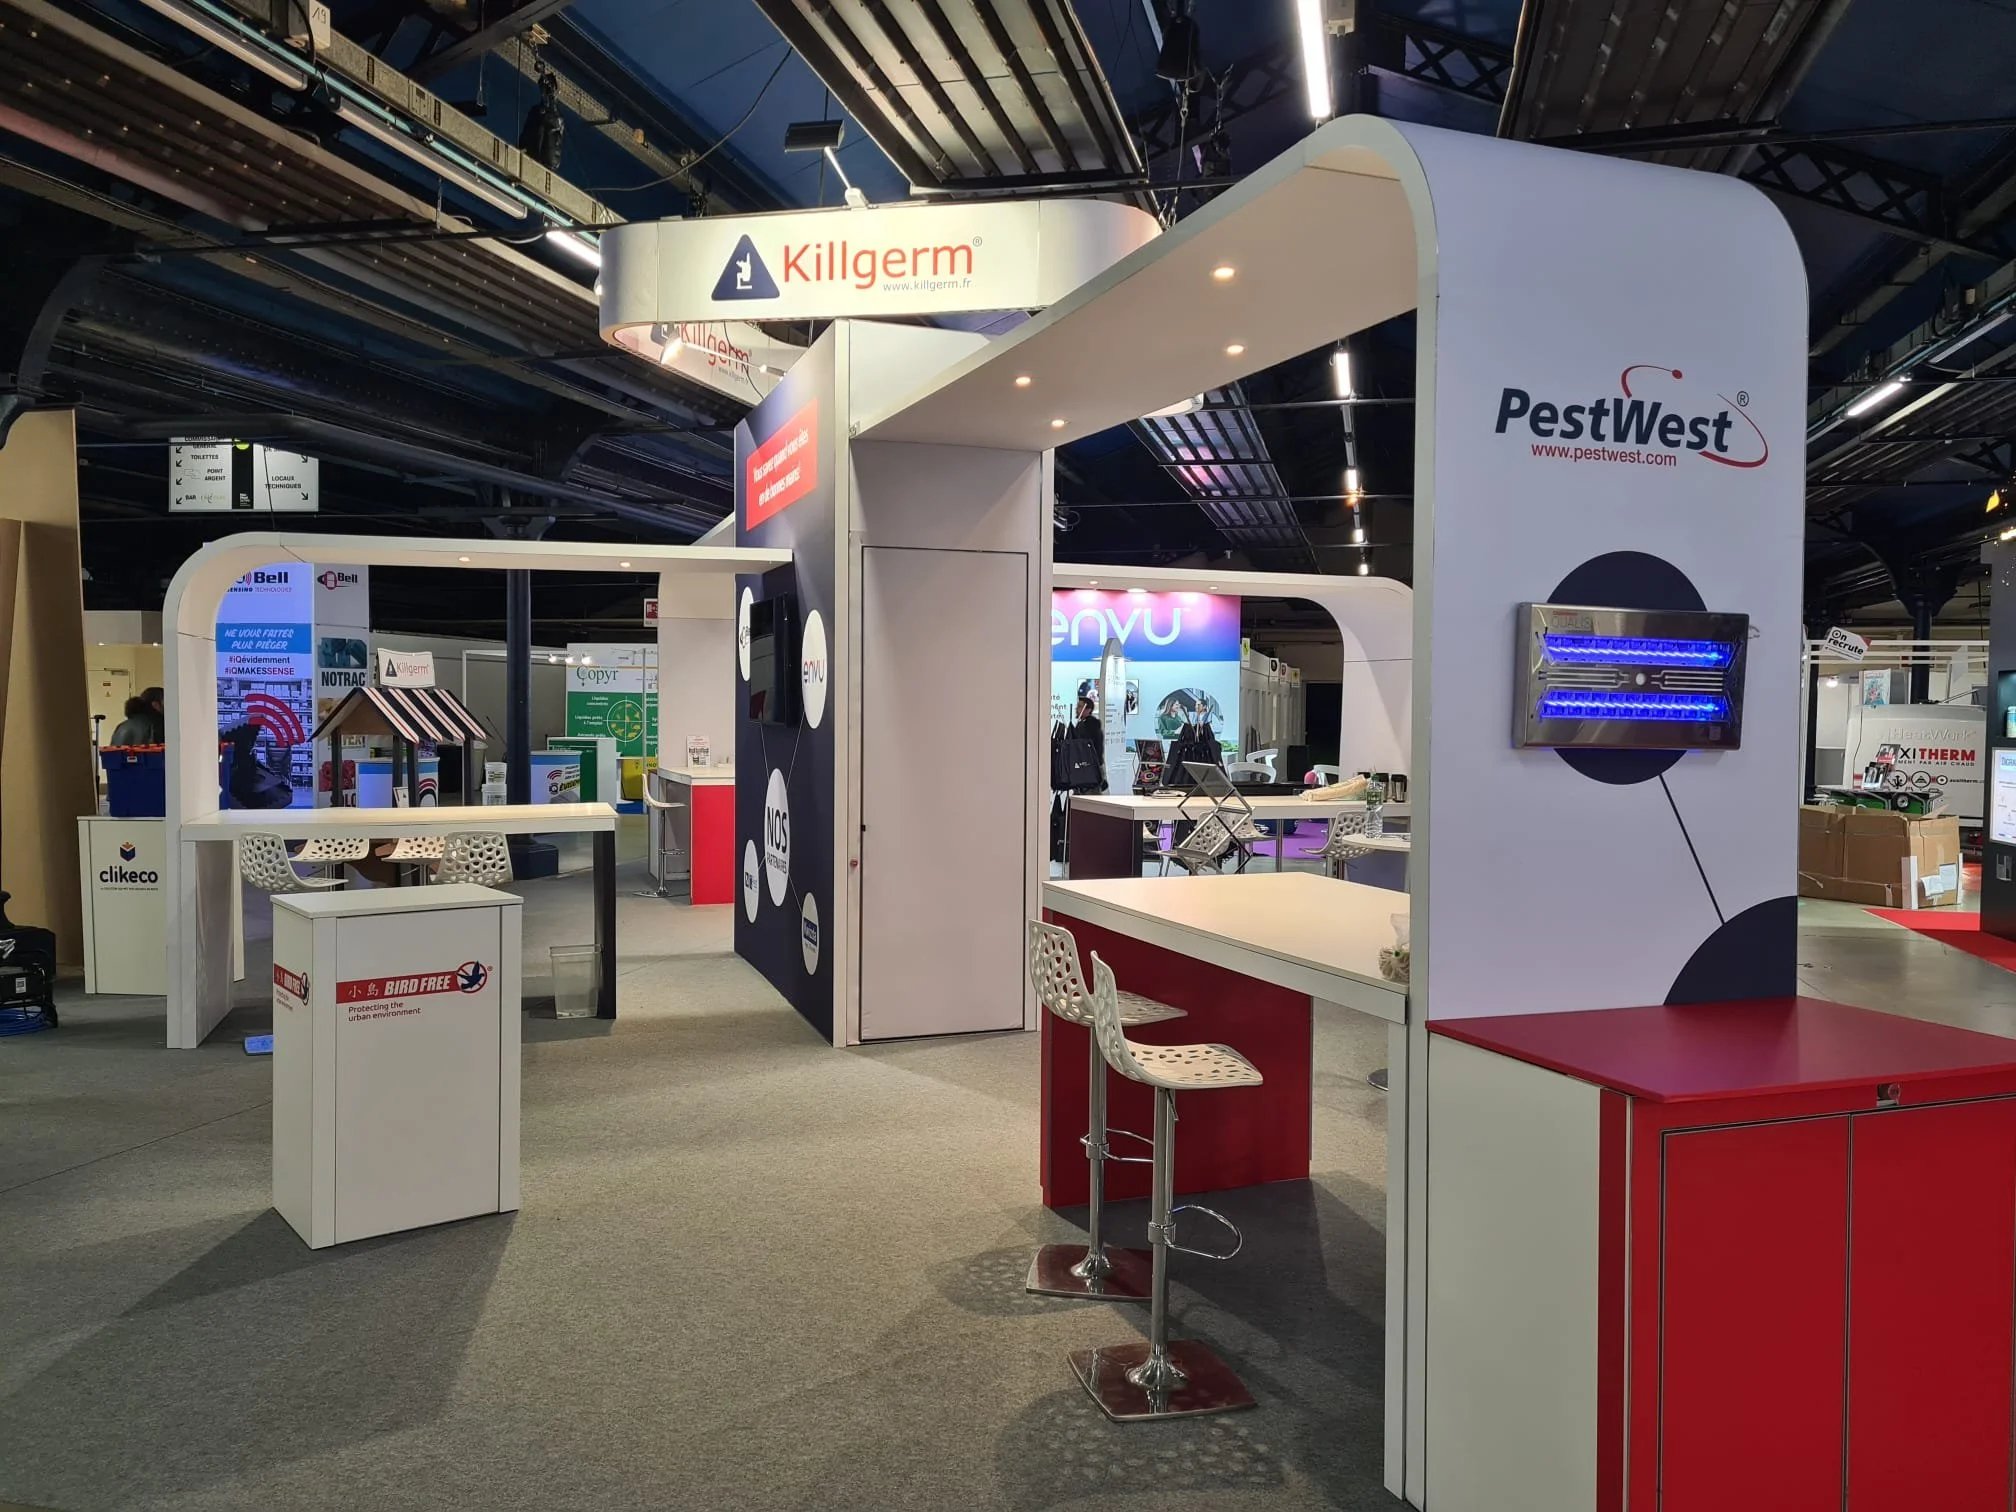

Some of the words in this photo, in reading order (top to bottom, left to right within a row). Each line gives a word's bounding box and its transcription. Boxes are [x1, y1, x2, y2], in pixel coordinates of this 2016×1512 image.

[783, 240, 974, 290] Killgerm
[882, 278, 971, 292] www.killgerm.fr
[1494, 387, 1733, 453] PestWest
[1531, 443, 1677, 466] www.pestwest.com
[253, 571, 289, 584] Bell
[337, 571, 358, 584] Bell
[224, 628, 236, 639] NE
[238, 629, 261, 639] VOUS
[262, 628, 295, 639] FAITES
[1831, 629, 1848, 642] On
[231, 640, 253, 650] PLUS
[1827, 637, 1865, 655] recrute
[229, 655, 291, 665] #iQévidemment
[224, 667, 295, 676] #iQMAKESSENSE
[396, 661, 429, 677] Killgerm
[576, 665, 619, 686] Copyr
[803, 656, 825, 684] envu
[321, 671, 366, 687] NOTRAC
[1899, 747, 1976, 761] XITHERM
[767, 806, 787, 854] NOS
[99, 865, 159, 884] clikeco
[383, 977, 419, 996] BIRD
[419, 975, 452, 993] FREE
[348, 1002, 389, 1014] Protecting
[390, 1001, 404, 1010] the
[348, 1012, 371, 1022] urban
[372, 1007, 422, 1020] environment
